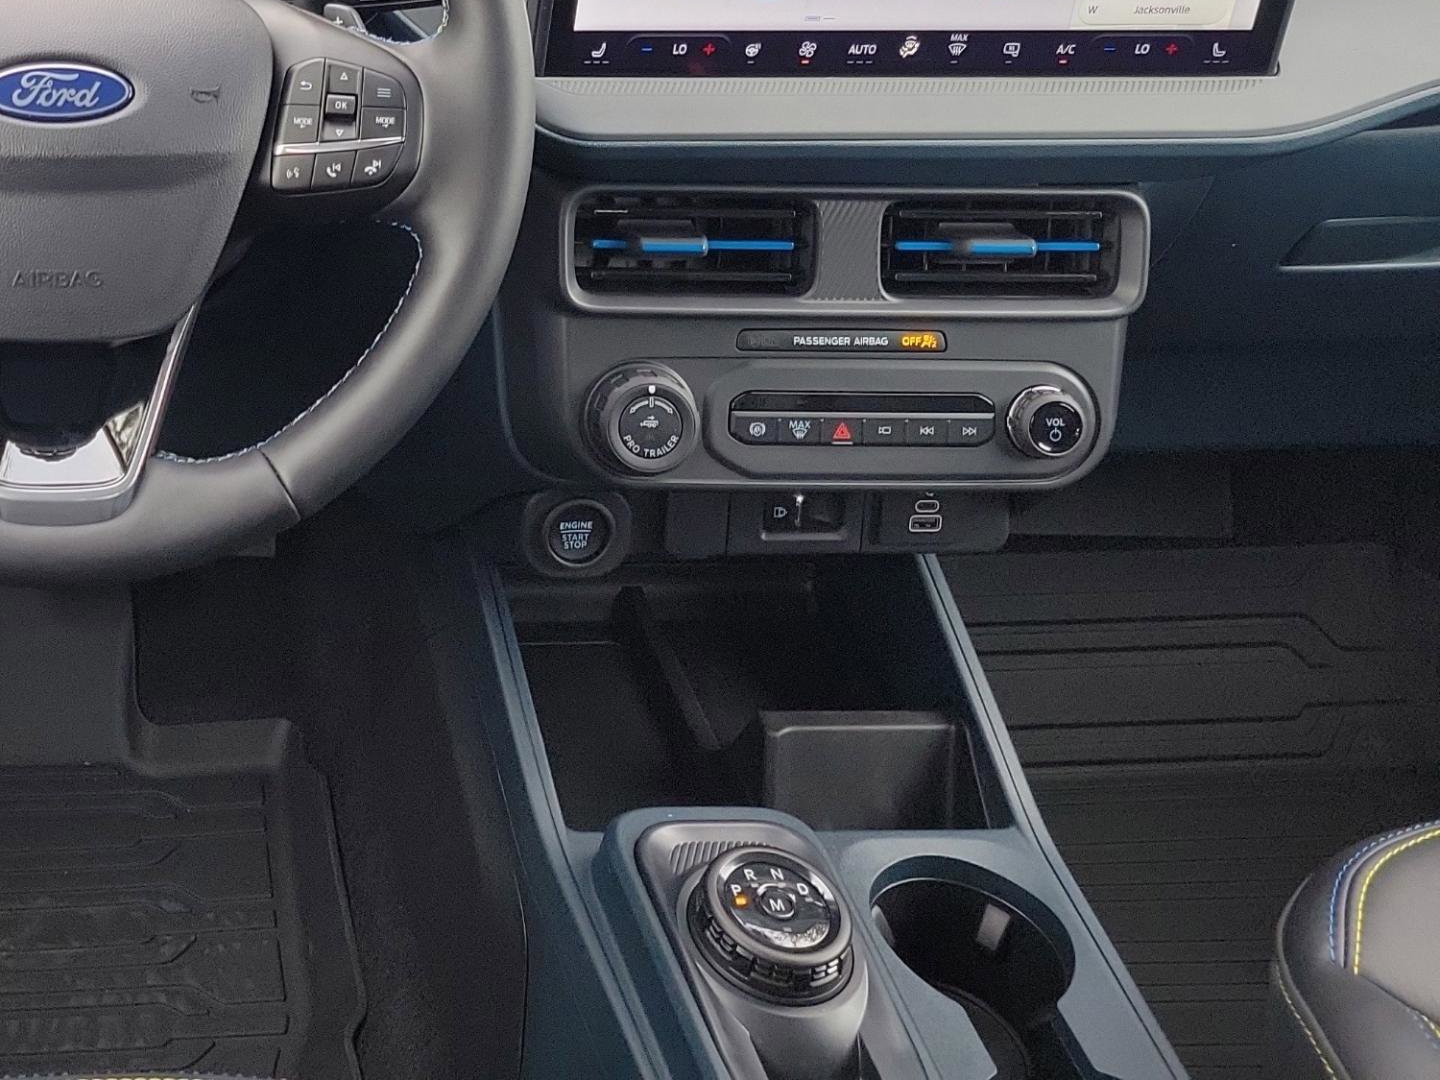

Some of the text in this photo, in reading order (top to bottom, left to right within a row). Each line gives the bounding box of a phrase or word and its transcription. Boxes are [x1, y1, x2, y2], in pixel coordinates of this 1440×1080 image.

[1087, 5, 1099, 15] W
[1133, 4, 1191, 16] Jacksonville
[950, 33, 969, 42] MAX
[672, 43, 687, 56] LO
[848, 43, 877, 56] AUTO
[1056, 43, 1076, 55] A/C
[1134, 43, 1150, 56] LO
[11, 71, 103, 109] Ford
[335, 100, 348, 110] OK
[11, 270, 104, 288] AIRBAG
[793, 335, 922, 347] PASSENGER AIRBAG OFF
[788, 420, 811, 429] MAX
[1046, 417, 1066, 427] VOL
[623, 434, 680, 458] PRO TRAILER
[560, 520, 593, 530] ENGINE
[562, 533, 590, 542] START
[564, 540, 588, 550] STOP
[743, 868, 757, 881] R
[770, 868, 785, 880] N
[731, 884, 743, 896] P
[796, 882, 809, 896] D
[768, 898, 785, 912] M
